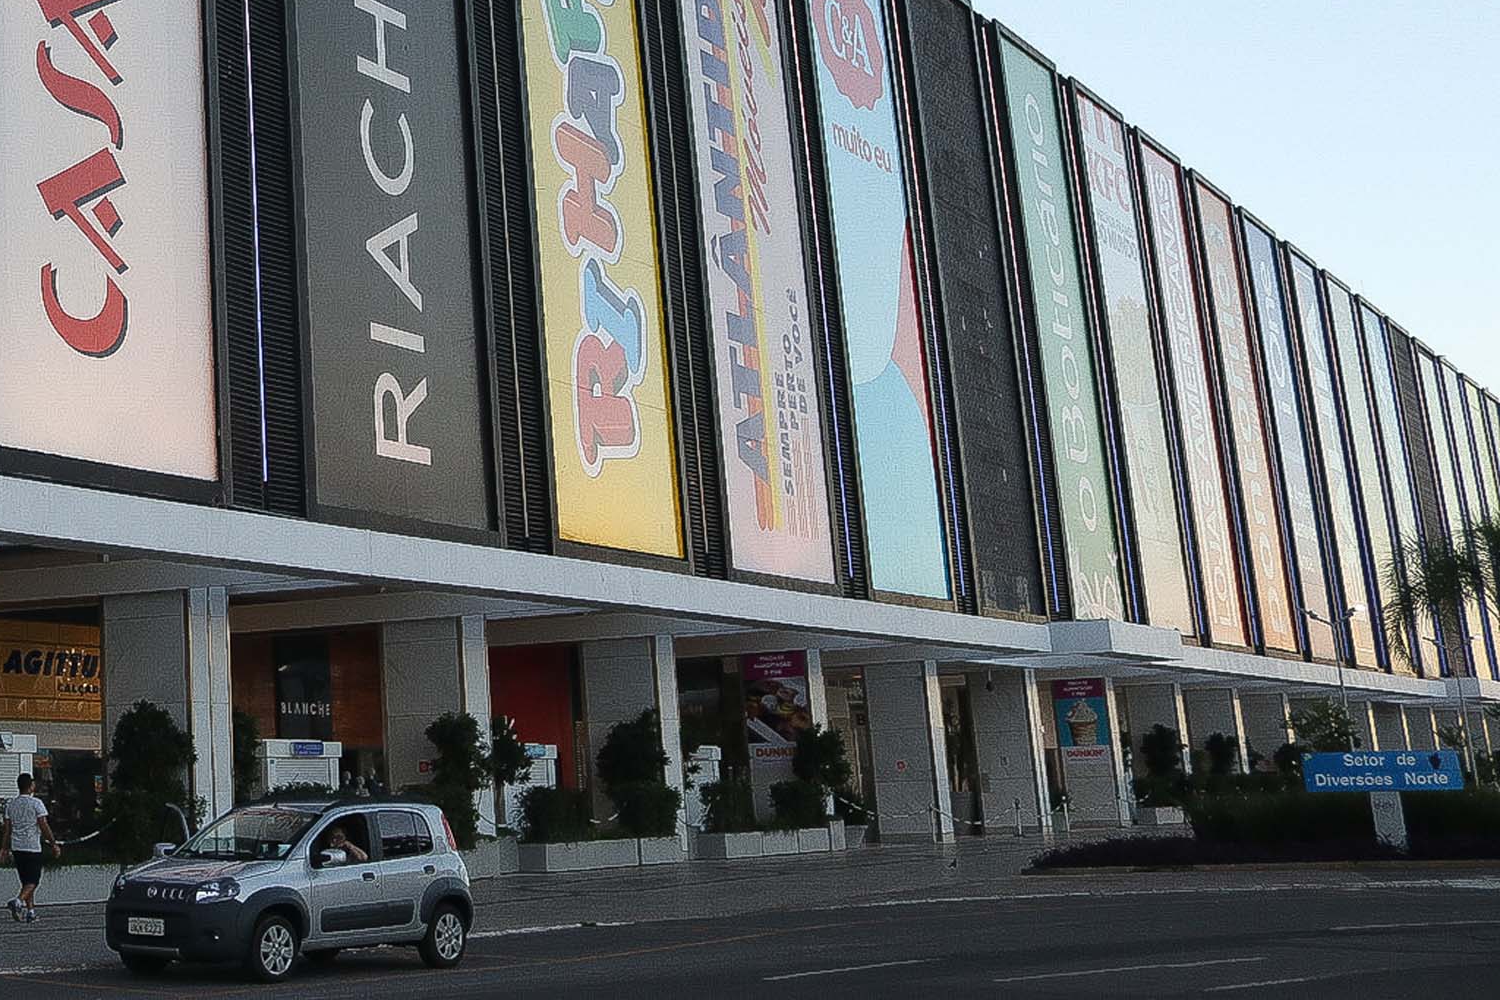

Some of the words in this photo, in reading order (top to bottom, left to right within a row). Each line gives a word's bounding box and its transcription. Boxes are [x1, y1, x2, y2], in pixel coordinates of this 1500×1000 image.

[831, 122, 873, 163] muito
[874, 145, 892, 174] eu
[786, 287, 803, 365] VOCÊ
[783, 333, 799, 431] PERTO
[796, 376, 808, 415] DE
[775, 371, 795, 497] SEMPRE
[2, 649, 100, 678] AGITTU
[57, 683, 100, 695] CALÇAD
[280, 701, 331, 717] BLANCHE
[1343, 753, 1385, 767] Setor
[1396, 753, 1416, 766] de
[1315, 772, 1394, 787] Diversões
[1404, 772, 1449, 785] Norte
